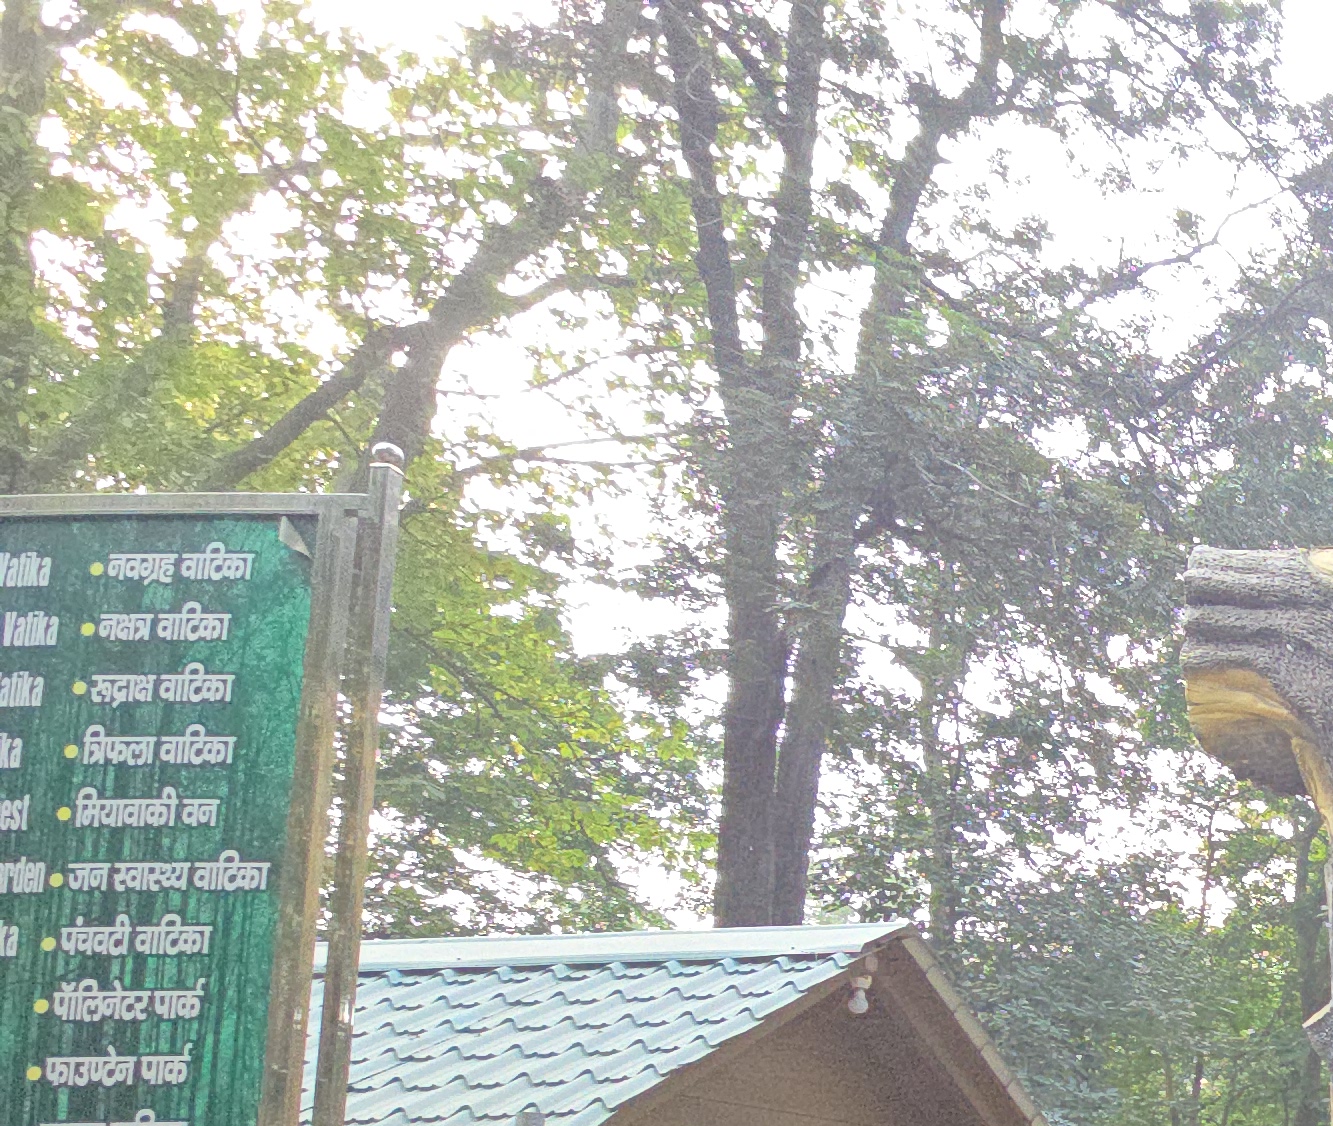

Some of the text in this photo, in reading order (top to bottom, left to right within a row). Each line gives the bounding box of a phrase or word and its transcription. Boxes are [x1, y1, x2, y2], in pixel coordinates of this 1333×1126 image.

[108, 542, 255, 585] नवग्रह वाटिका
[3, 611, 59, 647] Vatika
[98, 601, 232, 642] नक्षत्र वाटिका
[0, 671, 45, 708] atika
[159, 661, 235, 704] वाटिका
[82, 724, 236, 766] त्रिफला वाटिका
[75, 787, 220, 828] मियावाकी वन
[68, 850, 270, 893] जन स्वास्थ्य वाटिका
[61, 914, 132, 957] पंचवटी
[135, 913, 212, 956] वाटिका
[53, 977, 204, 1022] पॉलिनेटर पार्क
[46, 1042, 194, 1087] फाउण्टेन पार्क
